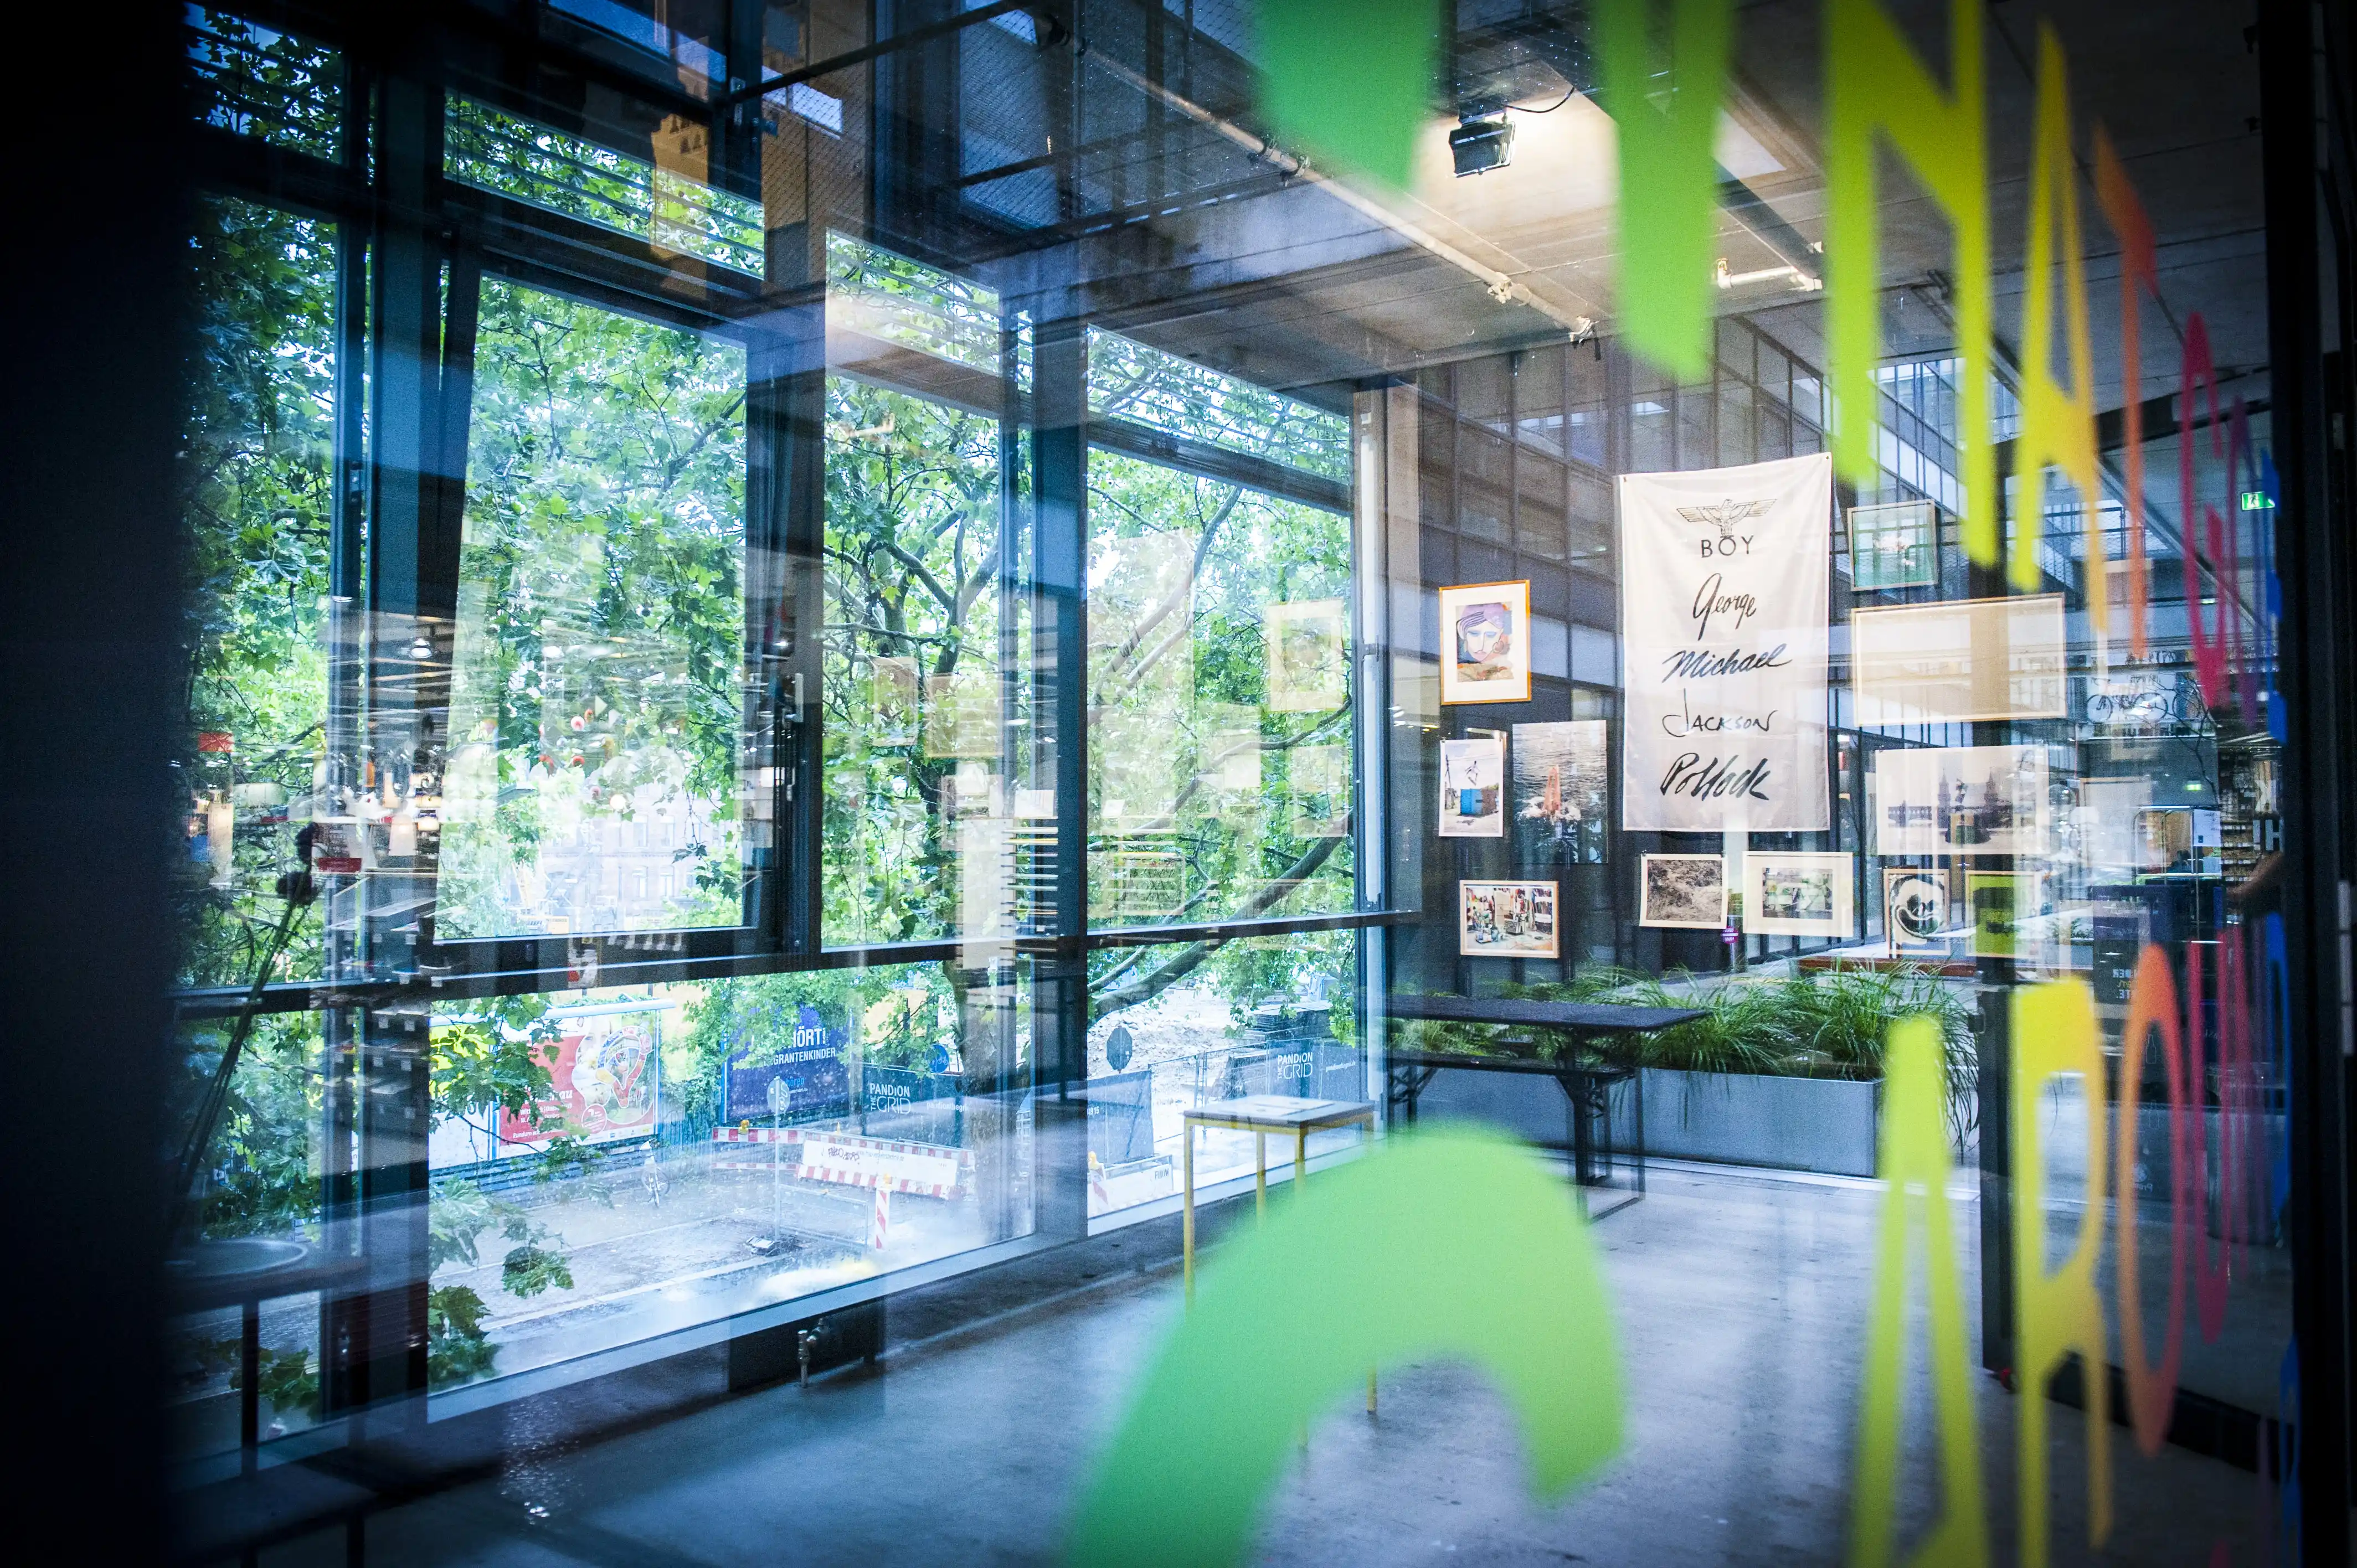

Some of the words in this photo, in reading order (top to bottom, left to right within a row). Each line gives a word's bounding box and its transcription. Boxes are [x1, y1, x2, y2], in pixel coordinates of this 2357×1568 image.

[1701, 535, 1754, 558] BOY
[1692, 573, 1757, 641] George
[1662, 643, 1793, 684] Michael
[1660, 752, 1769, 801] Pollock
[771, 1047, 837, 1066] GRANTENKINDER
[1283, 1062, 1313, 1080] GRID
[877, 1096, 911, 1115] GRID
